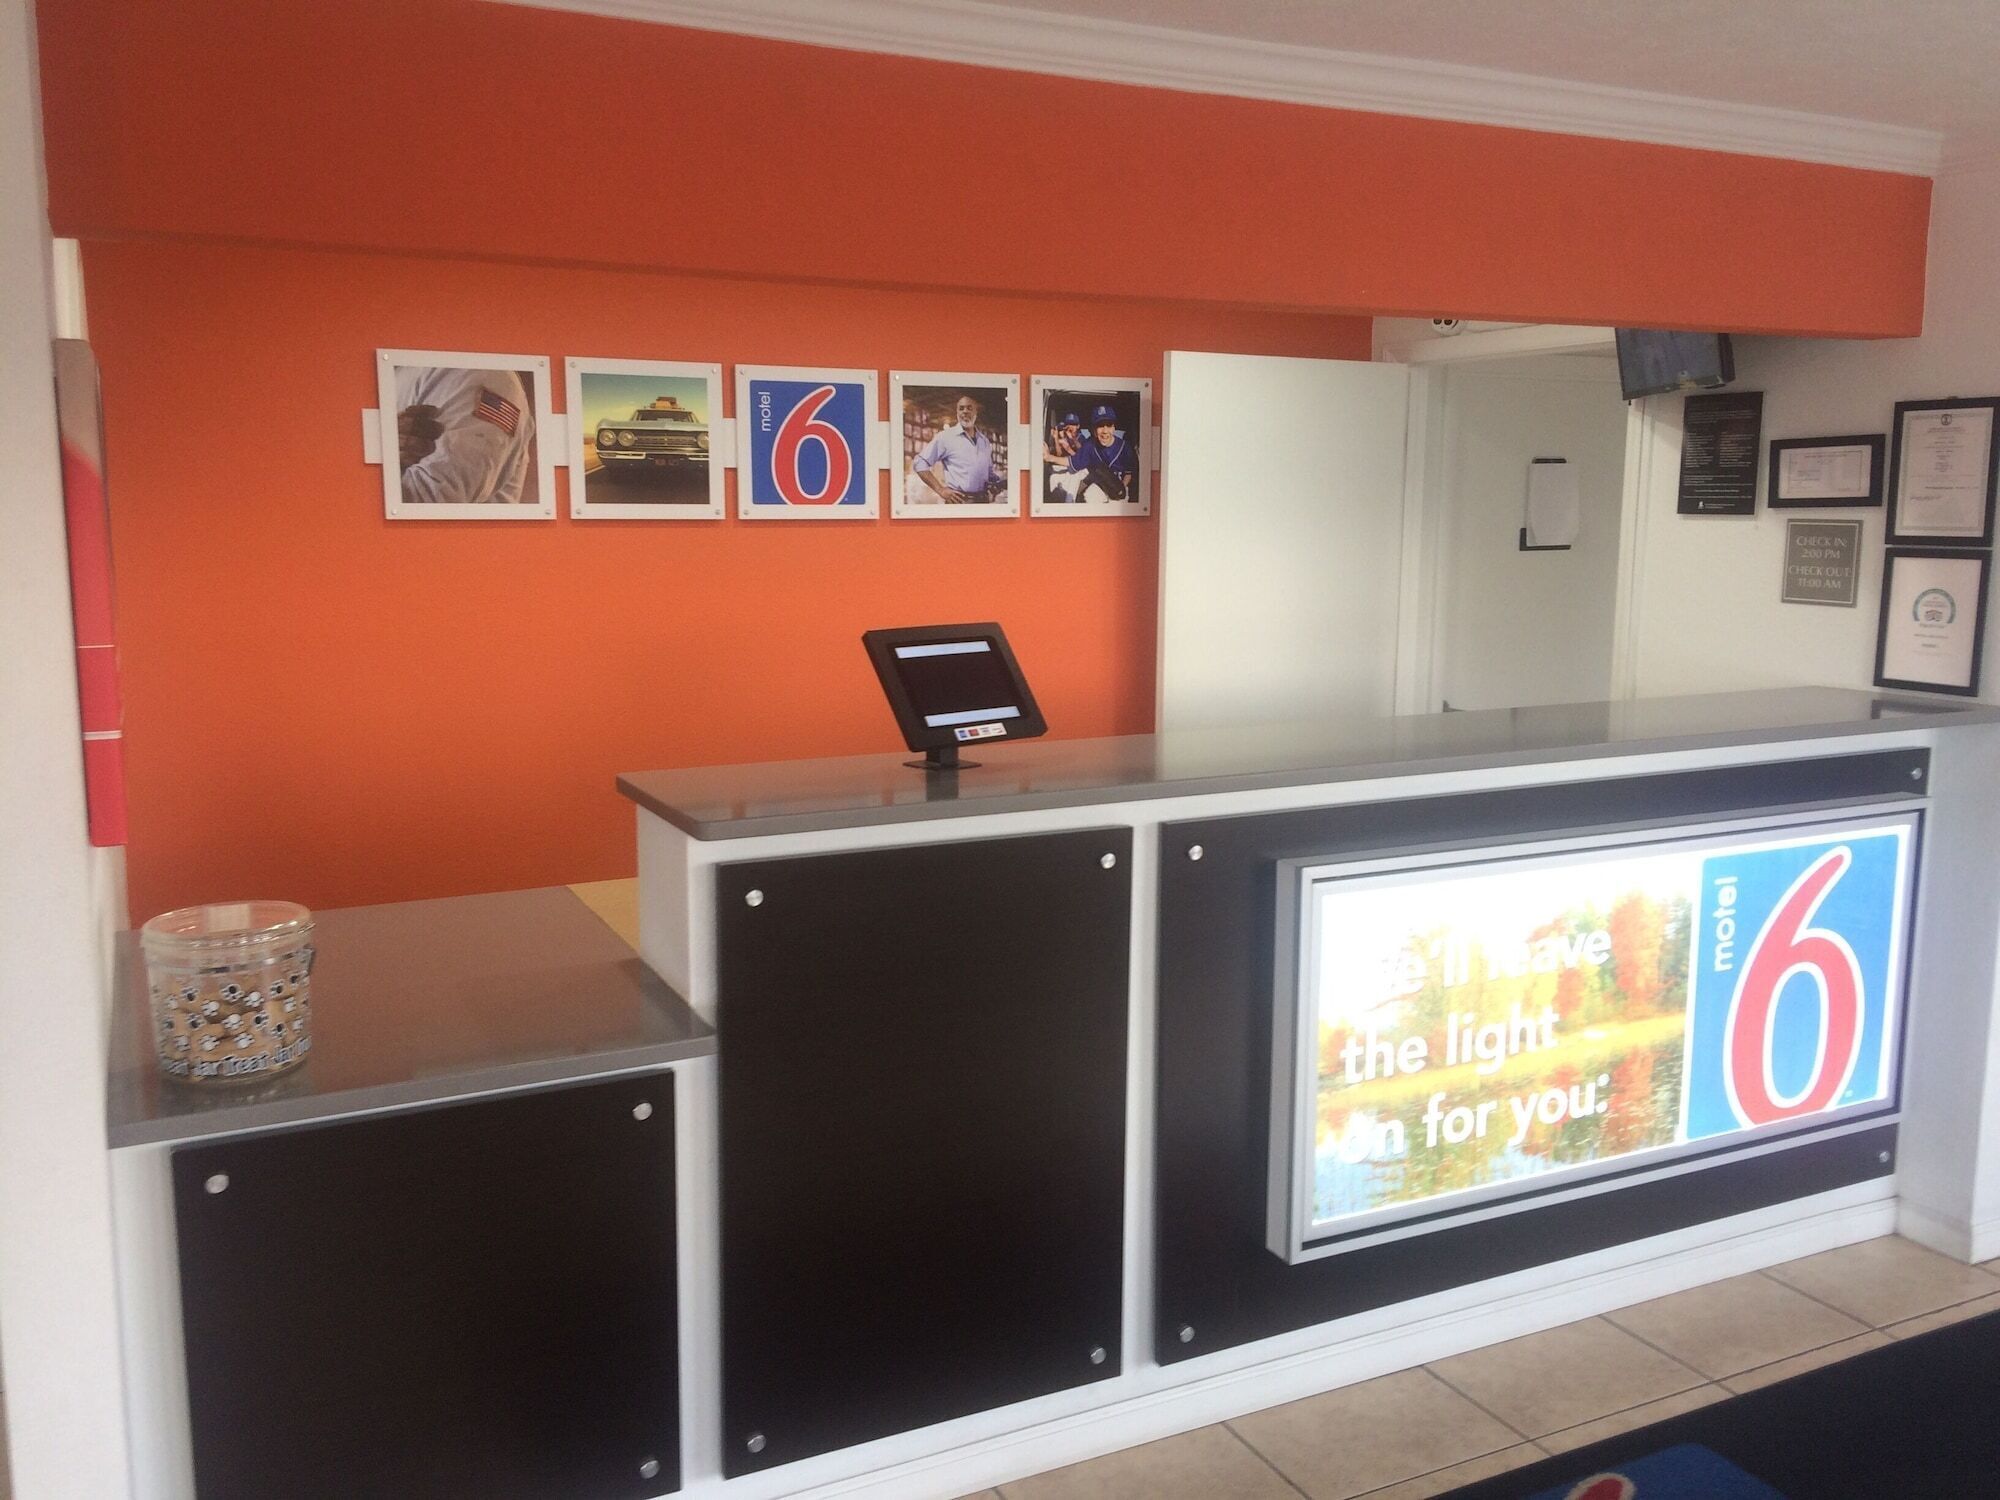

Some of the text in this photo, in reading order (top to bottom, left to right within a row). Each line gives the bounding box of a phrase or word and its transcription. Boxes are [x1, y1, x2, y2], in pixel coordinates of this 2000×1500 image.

[758, 385, 852, 506] motel 6
[1796, 535, 1832, 547] CHECK
[1824, 549, 1841, 559] PM
[1788, 565, 1823, 576] CHECK
[1823, 578, 1841, 589] AM
[1713, 846, 1865, 1130] motel 6
[1340, 1002, 1559, 1083] the light
[1422, 1091, 1497, 1147] for
